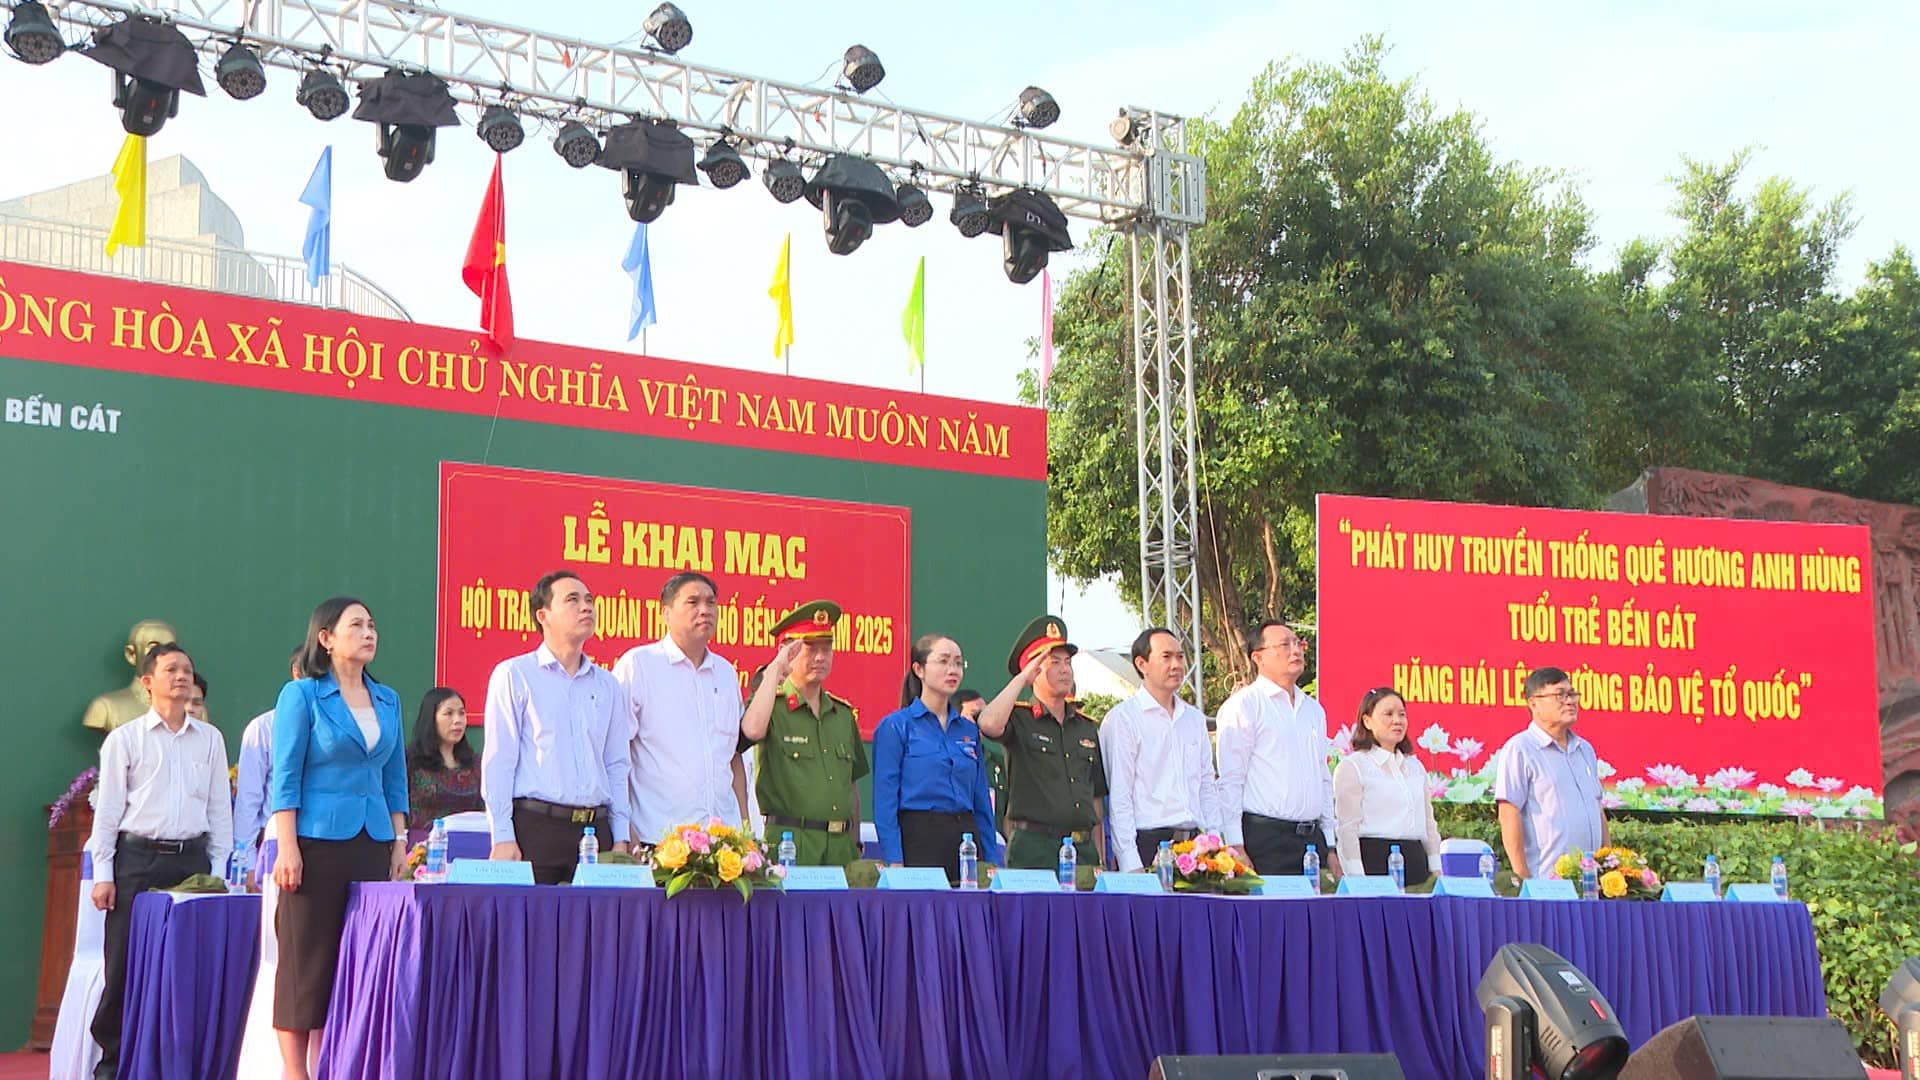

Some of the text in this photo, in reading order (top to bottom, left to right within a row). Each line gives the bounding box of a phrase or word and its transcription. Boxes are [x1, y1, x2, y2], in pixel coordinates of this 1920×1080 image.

[5, 393, 122, 434] BẾN CÁT
[110, 300, 217, 359] HÒA
[226, 317, 290, 369] XÃ
[302, 326, 385, 389] HỘI
[398, 339, 488, 393] CHỦ
[499, 362, 629, 412] NGHĨA
[639, 373, 727, 431] VIỆT
[736, 391, 817, 435] NAM
[825, 400, 929, 448] MUÔN
[938, 412, 1010, 458] NĂM
[563, 500, 806, 586] LỄ KHAI MẠC
[1339, 518, 1861, 593] “PHÁT HUY TRUYỀN THỐNG QUÊ HƯƠNG ANH HÙNG
[460, 577, 492, 638] HỘI
[497, 588, 537, 642] TRẠ
[592, 589, 641, 641] QUÂN
[707, 591, 740, 646] HỐ
[742, 594, 776, 648] BẾN
[854, 614, 894, 655] 2025
[1507, 590, 1697, 650] TUỔI TRẺ BẾN CÁT
[1393, 656, 1813, 724] HĂNG HÁI LÊ ỜNG BẢO VỆ TỔ QUỐC”
